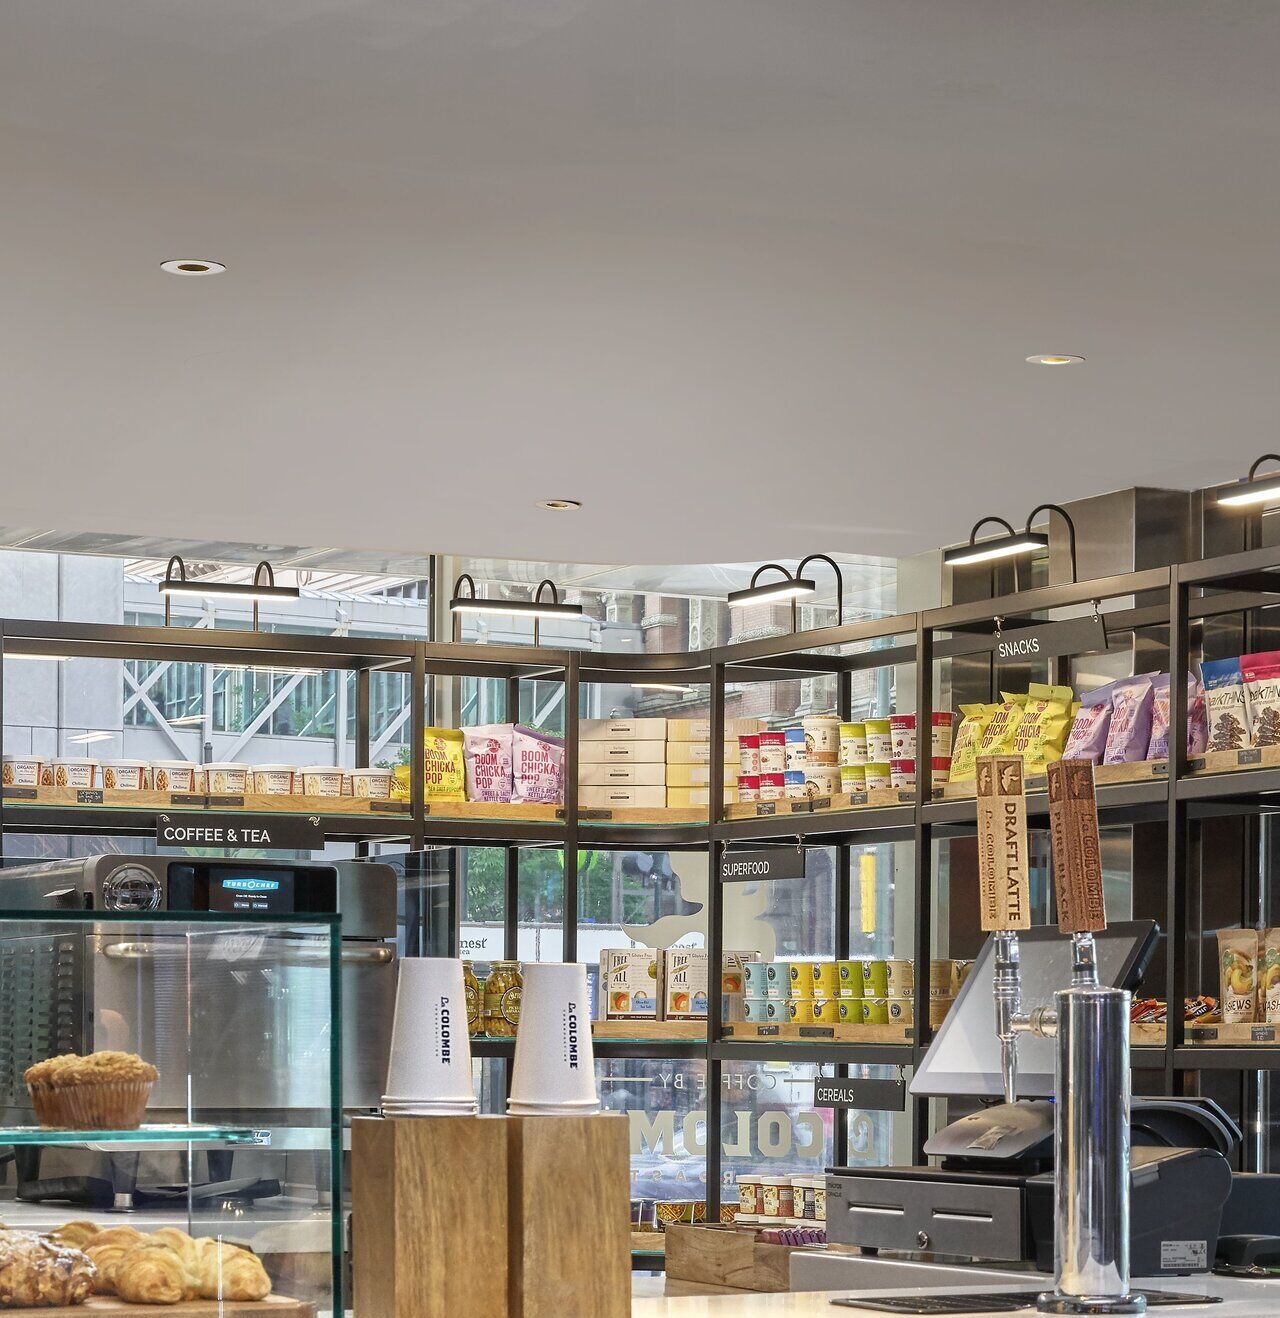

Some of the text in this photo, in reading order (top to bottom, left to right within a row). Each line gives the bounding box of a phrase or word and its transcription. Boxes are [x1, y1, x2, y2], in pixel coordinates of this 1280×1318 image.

[998, 638, 1040, 658] SNACKS
[425, 748, 448, 761] BOOM
[475, 753, 498, 766] BOOM
[521, 750, 549, 762] BOOM
[425, 760, 456, 774] CHICKA
[475, 765, 507, 778] CHICKA
[520, 761, 557, 776] CHICKA
[425, 773, 443, 785] POP
[475, 777, 493, 789] POP
[164, 826, 271, 843] COFFEE & TEA
[722, 861, 770, 876] SUPERFOOD
[1004, 802, 1021, 922] DRAFT LATTE
[613, 955, 628, 968] FREE
[673, 955, 688, 968] FREE
[441, 1009, 451, 1064] COLOMBE
[568, 1015, 578, 1069] COLOMBE
[817, 1088, 854, 1103] CEREALS
